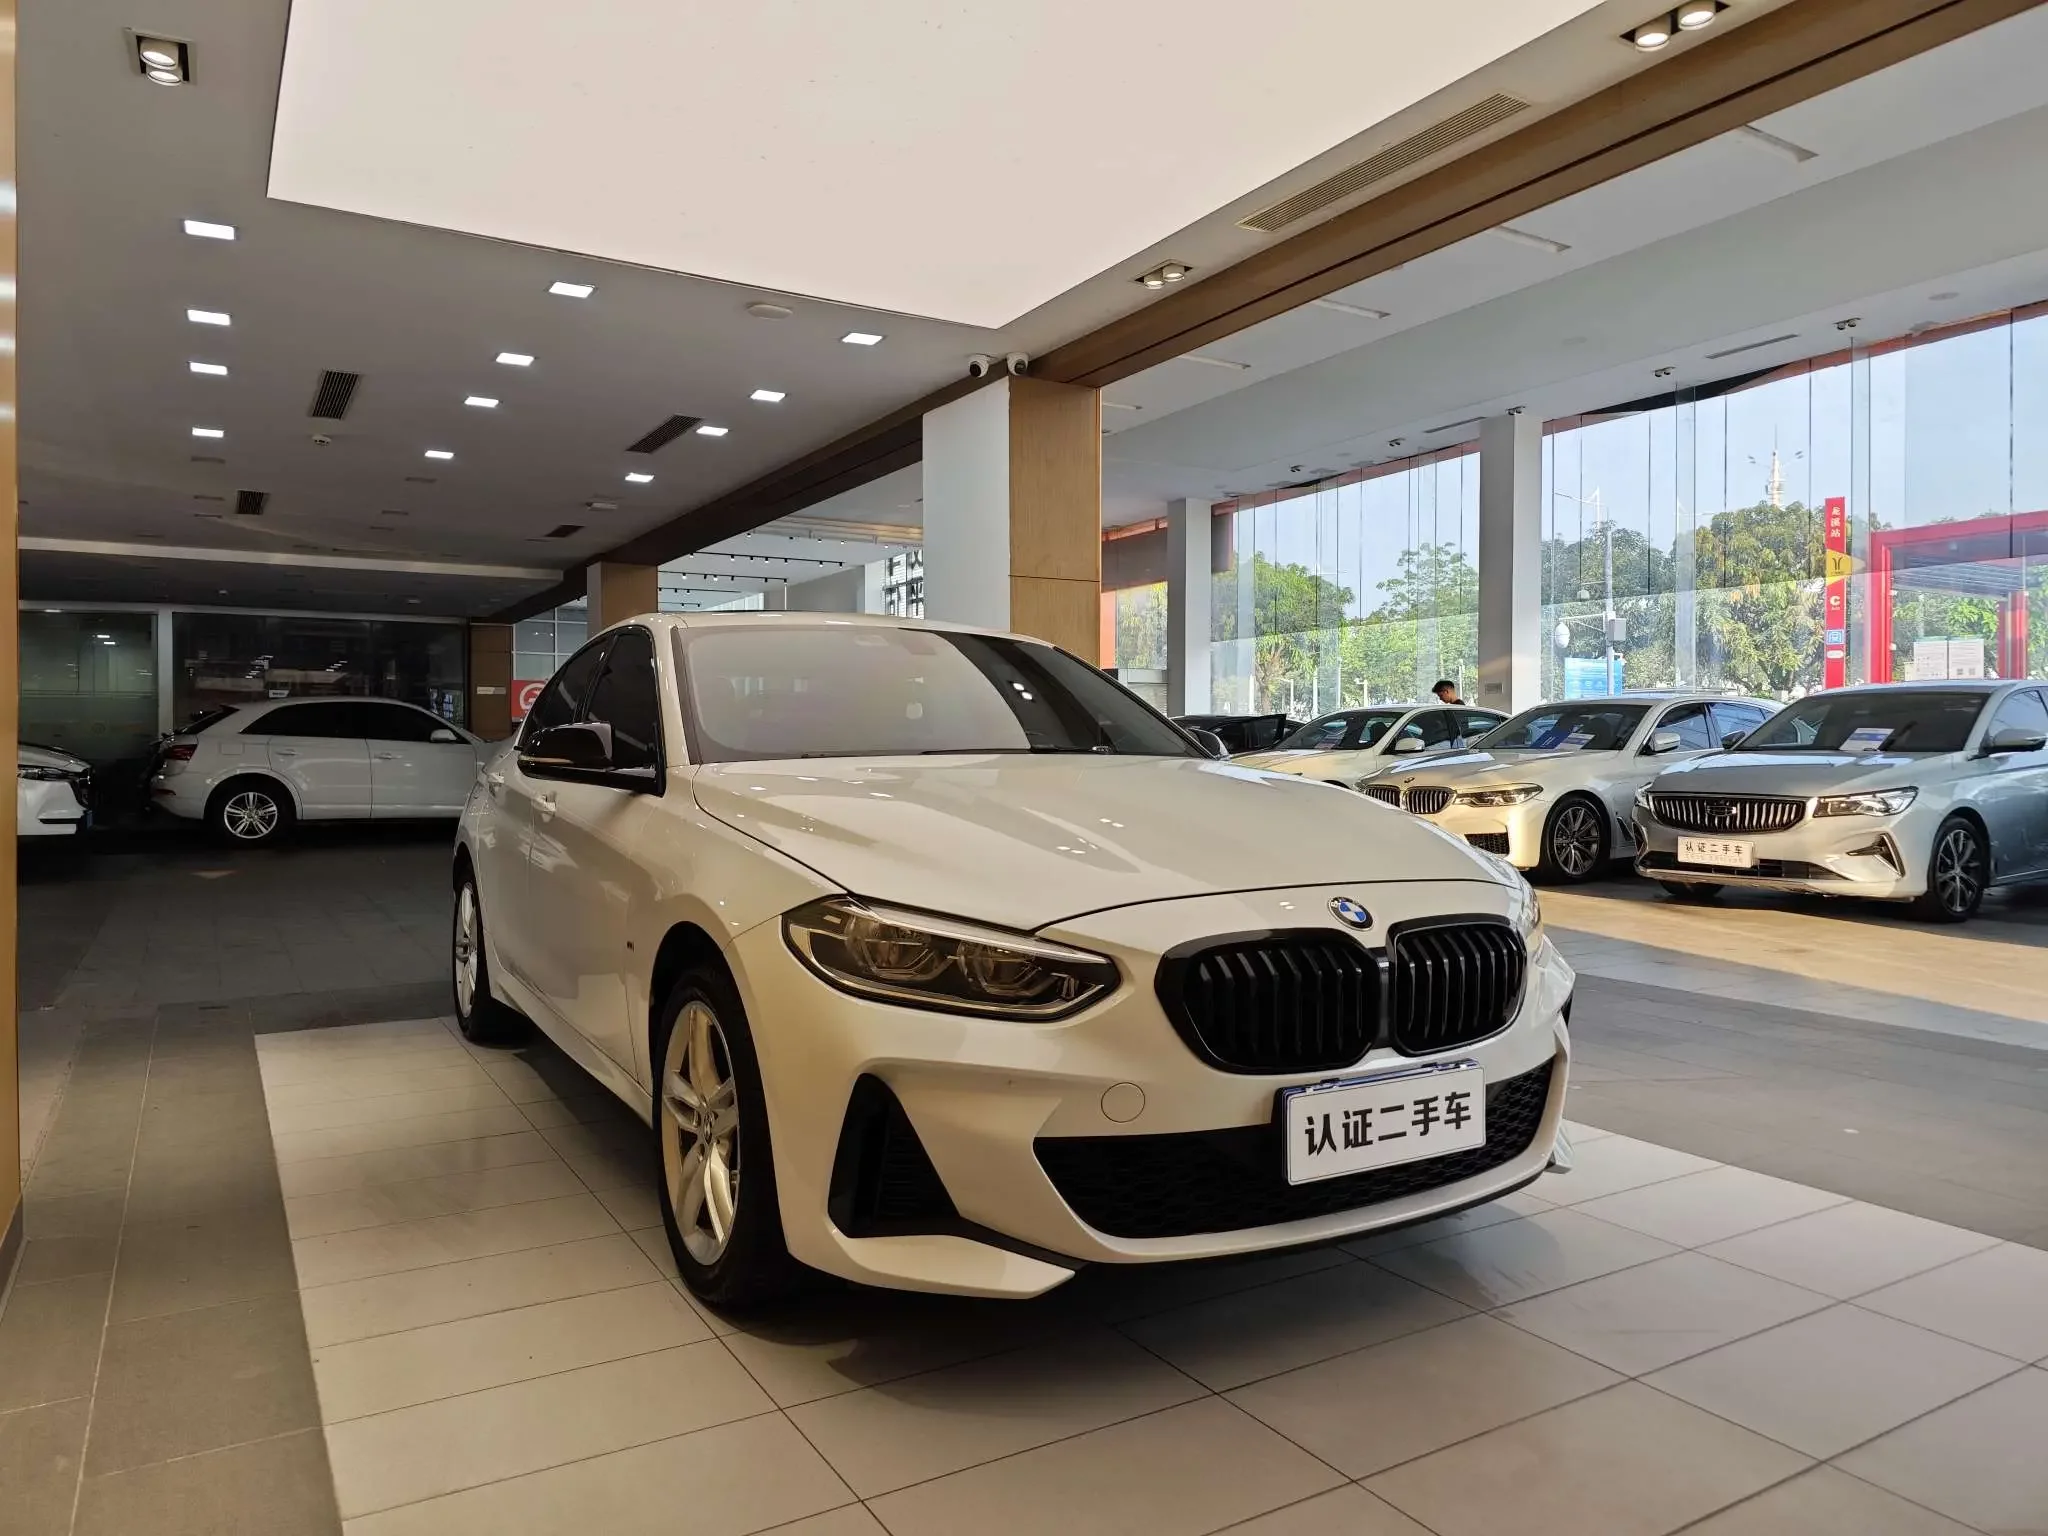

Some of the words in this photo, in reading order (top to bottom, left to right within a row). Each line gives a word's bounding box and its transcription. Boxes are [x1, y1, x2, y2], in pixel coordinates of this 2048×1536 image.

[1685, 841, 1743, 856] 认证二手车
[1304, 1091, 1471, 1156] 认证二手车
